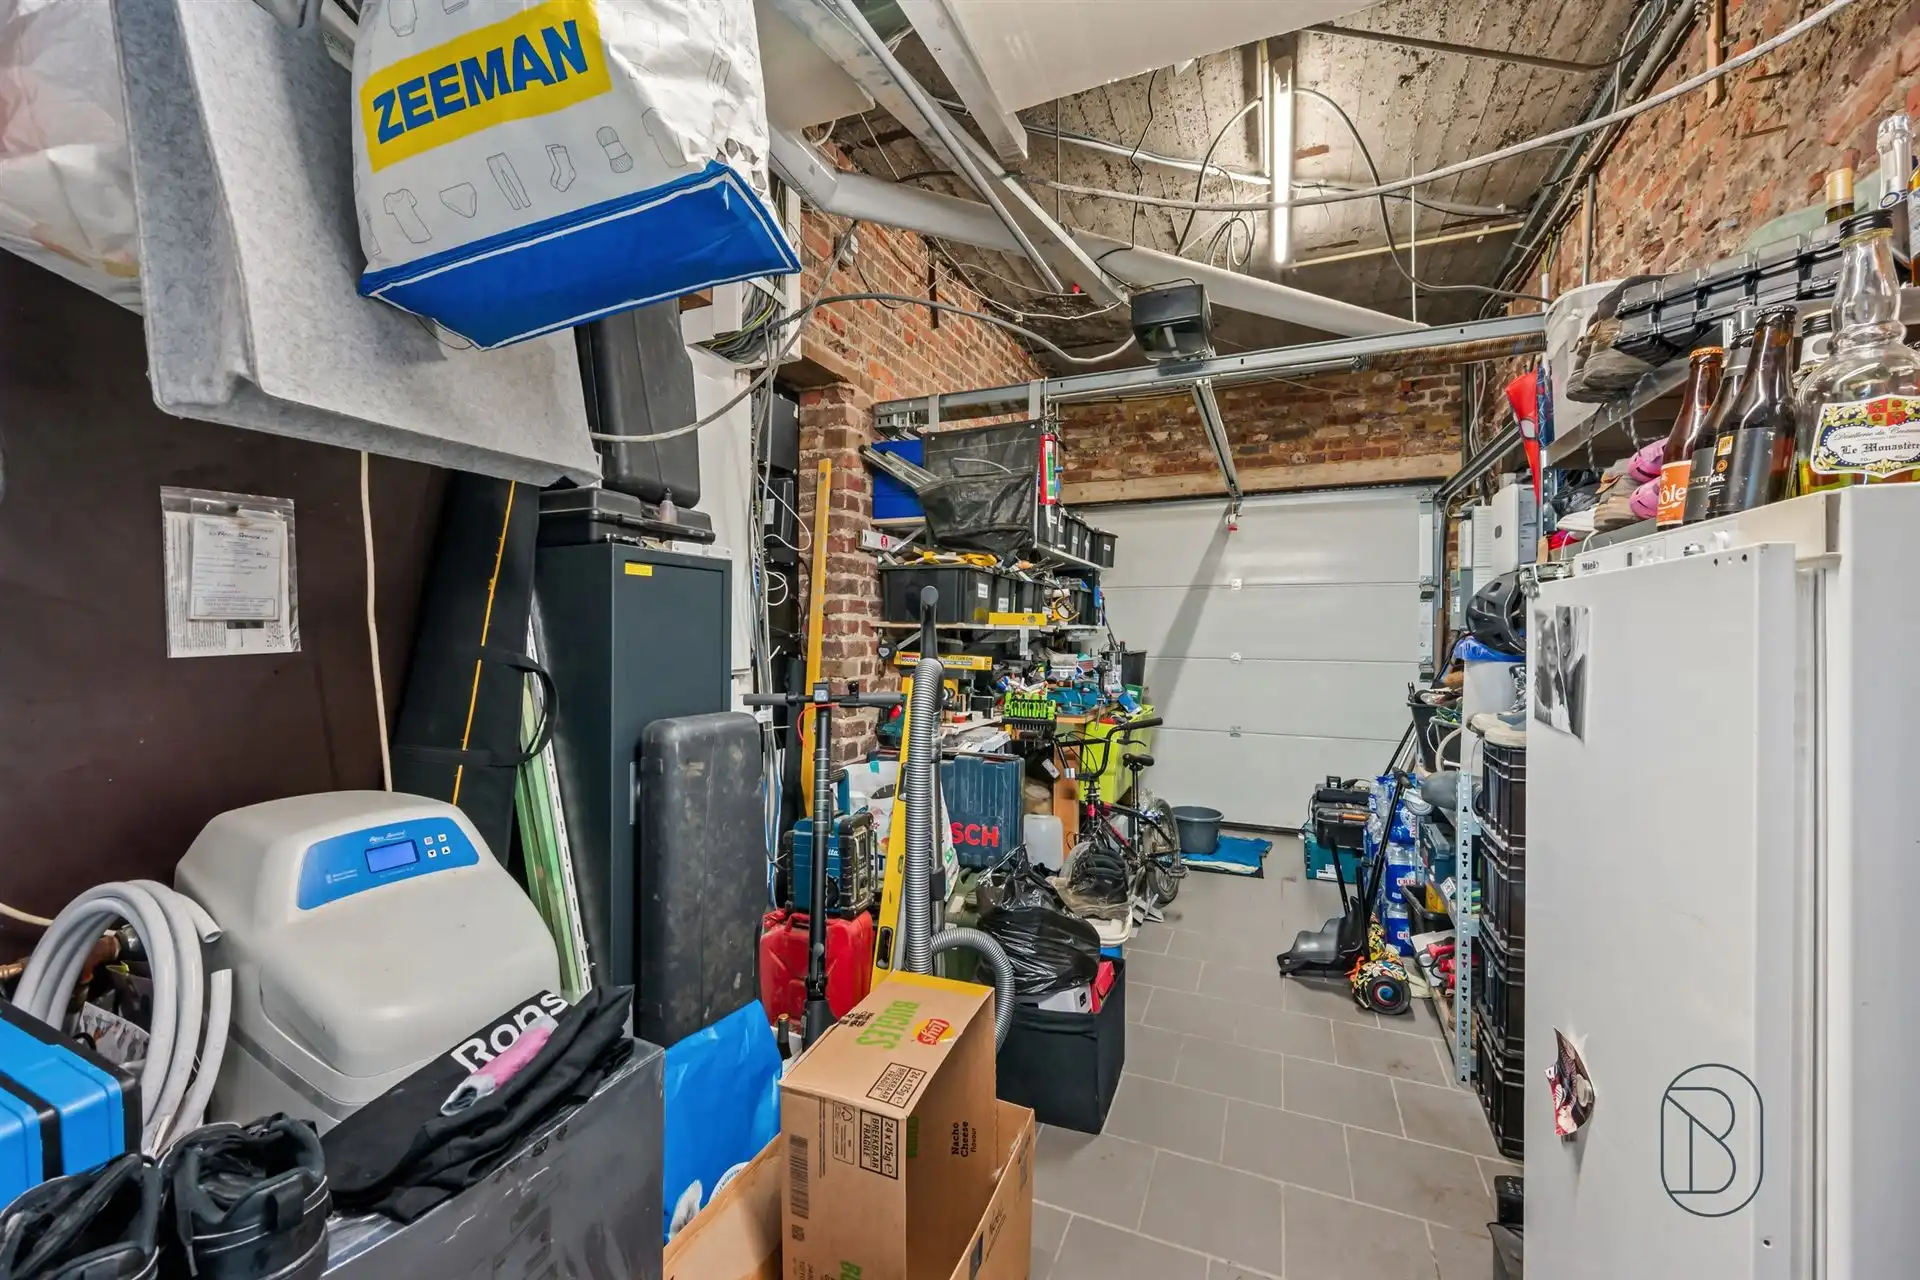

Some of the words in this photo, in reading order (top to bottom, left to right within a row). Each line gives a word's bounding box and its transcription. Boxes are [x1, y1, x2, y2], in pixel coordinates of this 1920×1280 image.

[373, 19, 588, 145] ZEEMAN
[1659, 484, 1687, 505] ôle
[827, 848, 840, 856] ita
[951, 821, 999, 848] SCH
[855, 1000, 920, 1049] BUGLES
[862, 1122, 870, 1158] FRAGILE
[870, 1117, 879, 1169] BREEKBAAR
[882, 1139, 893, 1162] 125g
[951, 1121, 960, 1156] Nacho
[960, 1120, 969, 1158] Cheese
